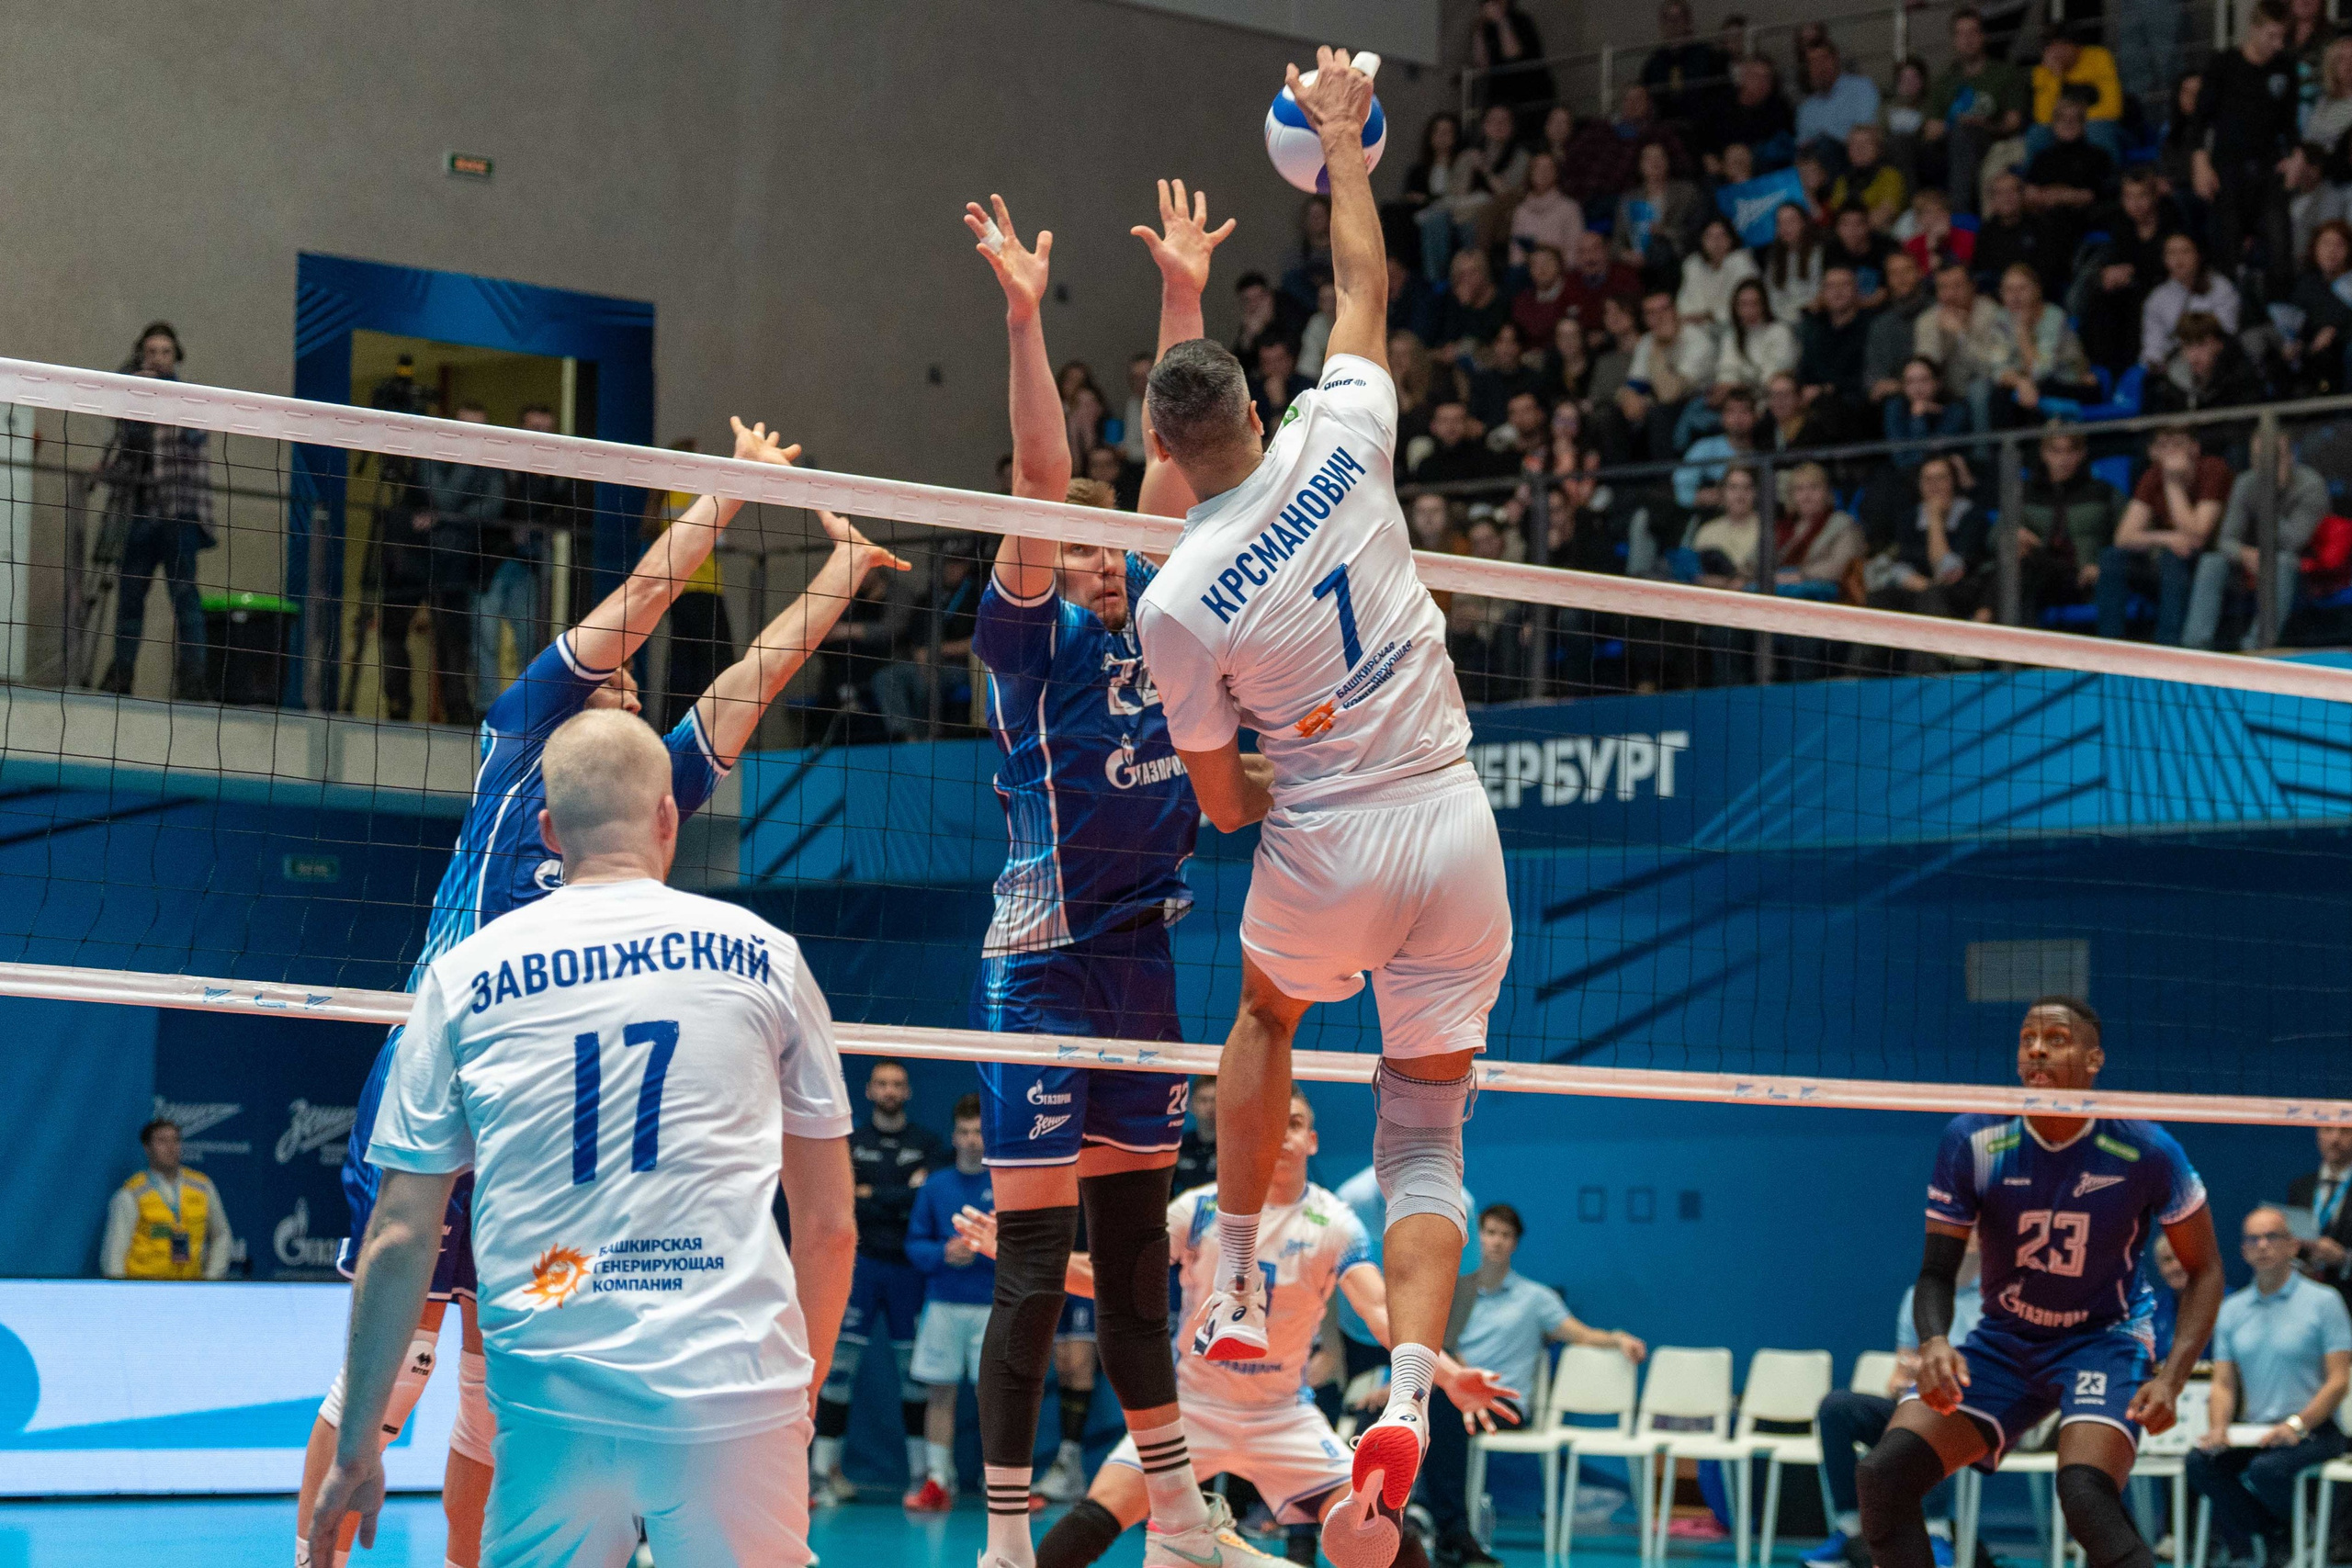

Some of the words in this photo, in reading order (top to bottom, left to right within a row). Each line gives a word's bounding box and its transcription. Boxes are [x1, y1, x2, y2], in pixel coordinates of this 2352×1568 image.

[1201, 446, 1366, 624] КРСМАНОВИЧ
[1312, 563, 1363, 673] 7
[1336, 641, 1396, 699] БАШКИРСКАЯ
[1467, 730, 1690, 810] ЕРБУРГ
[471, 931, 770, 1014] ЗАВОЛЖСКИЙ
[572, 1020, 680, 1185] 17
[594, 1257, 724, 1274] ГЕНЕРИРУЮЩАЯ
[599, 1237, 703, 1257] БАШКИРСКАЯ
[2016, 1209, 2091, 1278] 23
[593, 1278, 683, 1292] КОМПАНИЯ
[2075, 1371, 2108, 1395] 23
